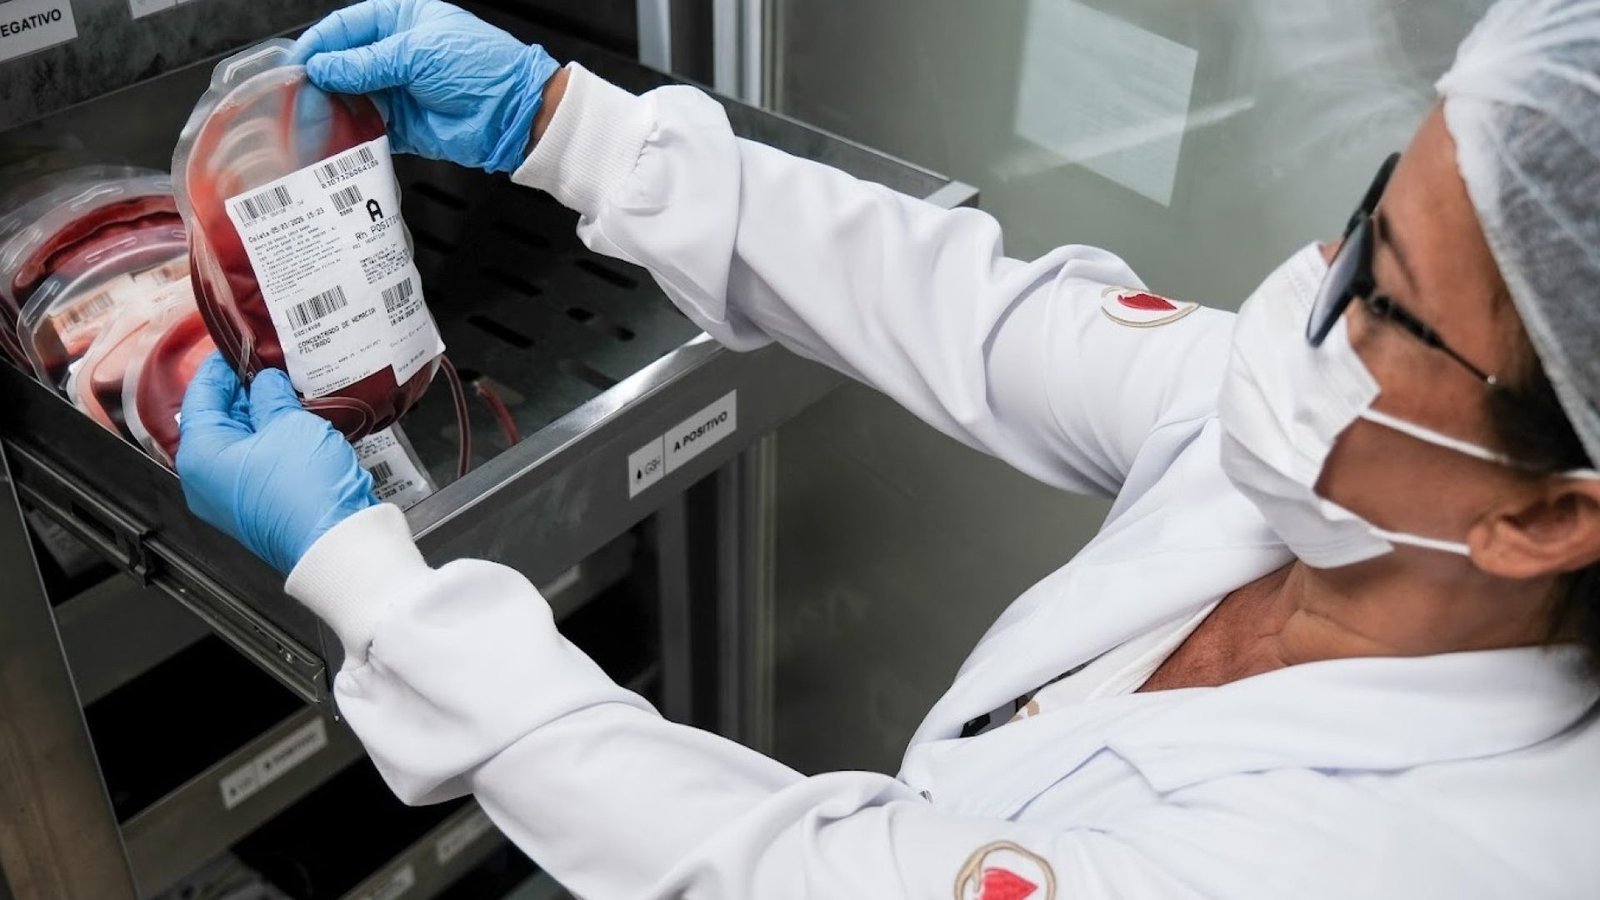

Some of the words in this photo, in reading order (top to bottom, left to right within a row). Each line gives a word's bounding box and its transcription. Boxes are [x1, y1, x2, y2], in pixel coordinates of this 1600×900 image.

[0, 8, 62, 38] EGATIVO
[366, 198, 384, 222] A
[297, 325, 340, 349] CONCENTRADO
[299, 337, 331, 355] FILTRADO
[673, 441, 681, 453] A
[682, 411, 728, 447] POSITIVO
